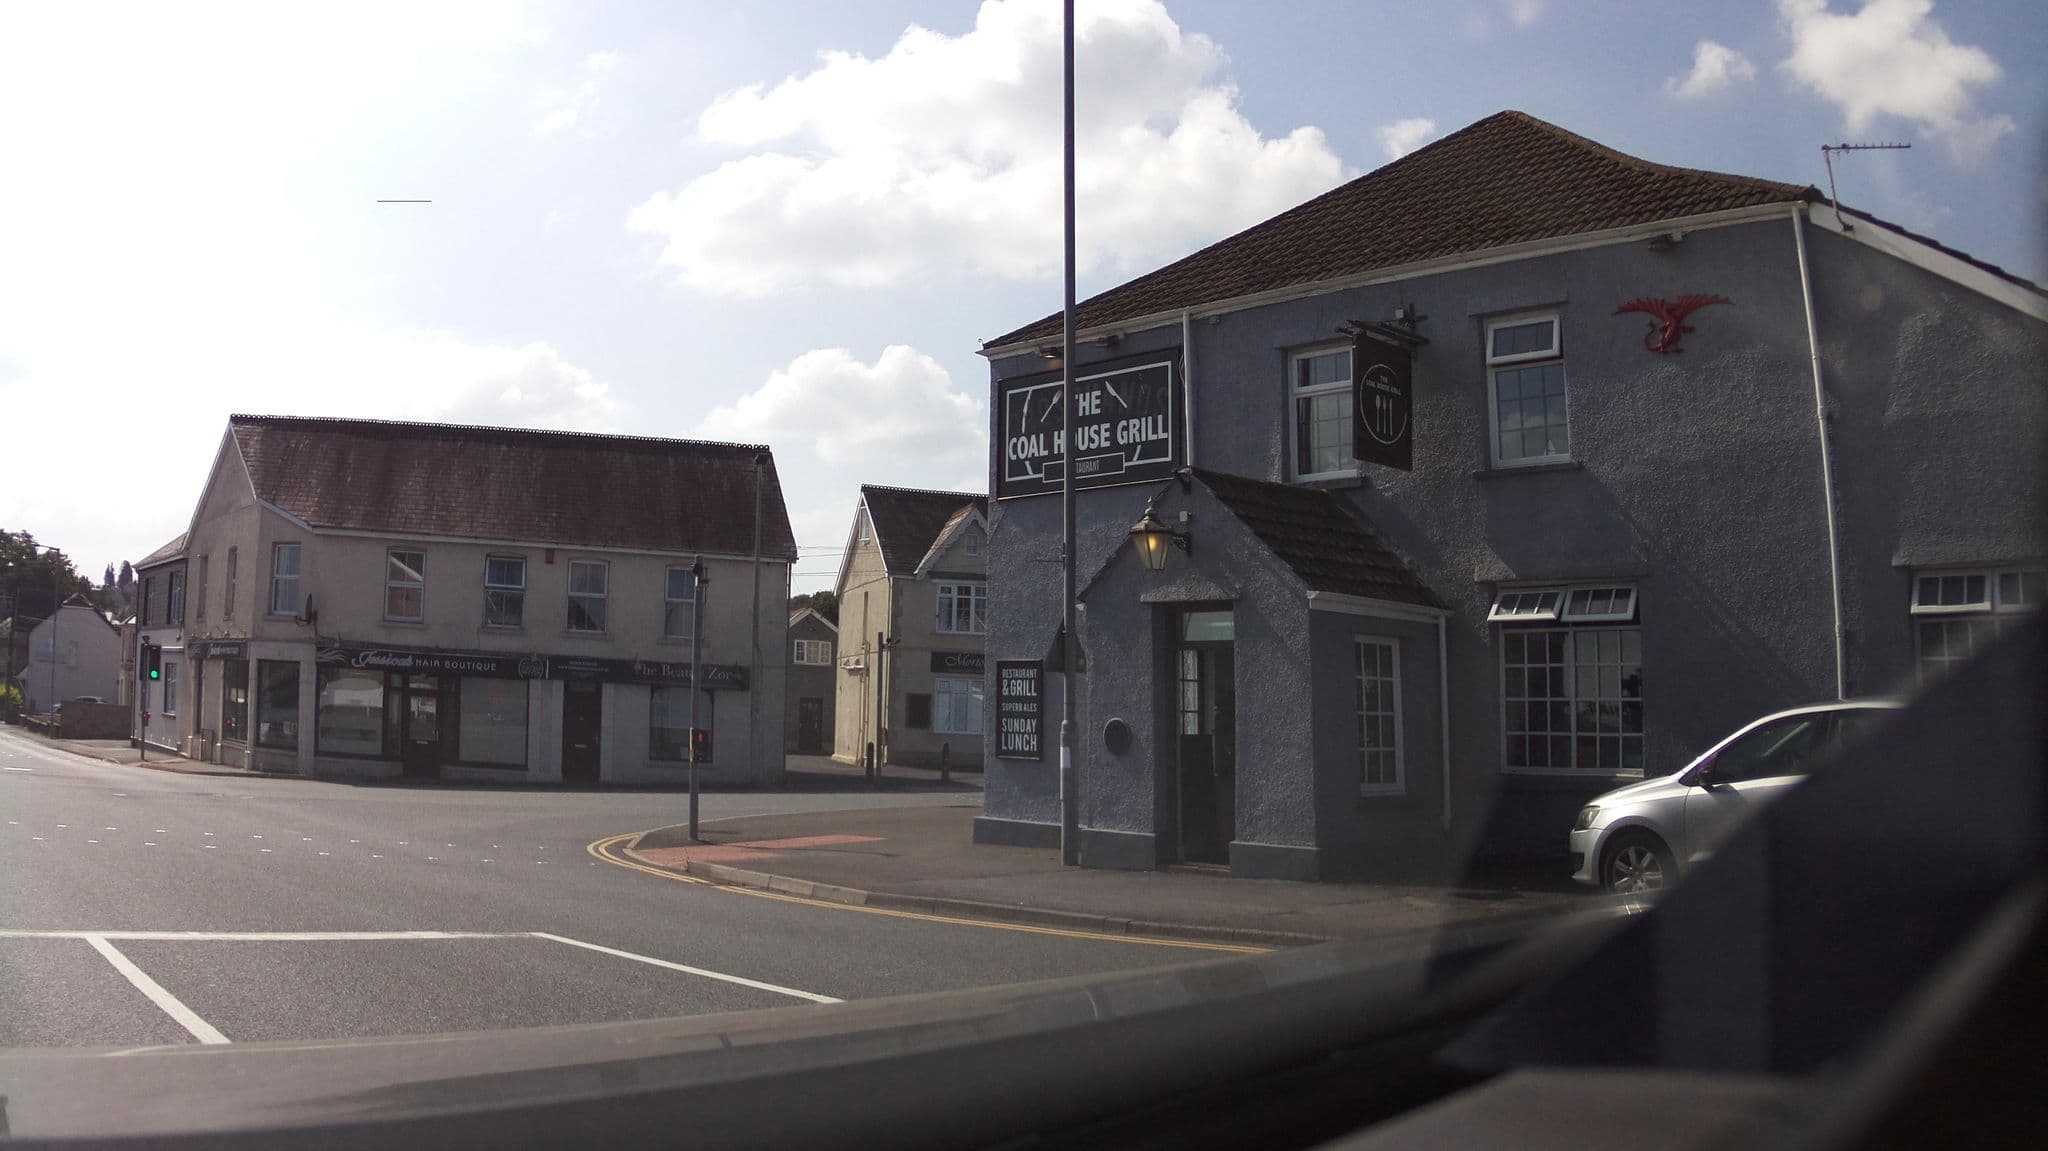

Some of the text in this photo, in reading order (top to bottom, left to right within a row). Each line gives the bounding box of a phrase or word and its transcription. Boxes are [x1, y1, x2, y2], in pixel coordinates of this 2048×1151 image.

[1074, 390, 1102, 417] HE
[1008, 414, 1169, 461] COAL HUSE GRILL
[415, 659, 441, 669] HAIR
[444, 661, 497, 672] BOUTIQUE
[1002, 668, 1038, 678] RESTAURANT
[1002, 679, 1038, 696] & GRILL
[1023, 702, 1037, 713] ALES
[1001, 718, 1037, 733] SUNDAY
[1001, 733, 1037, 752] LUNCH
